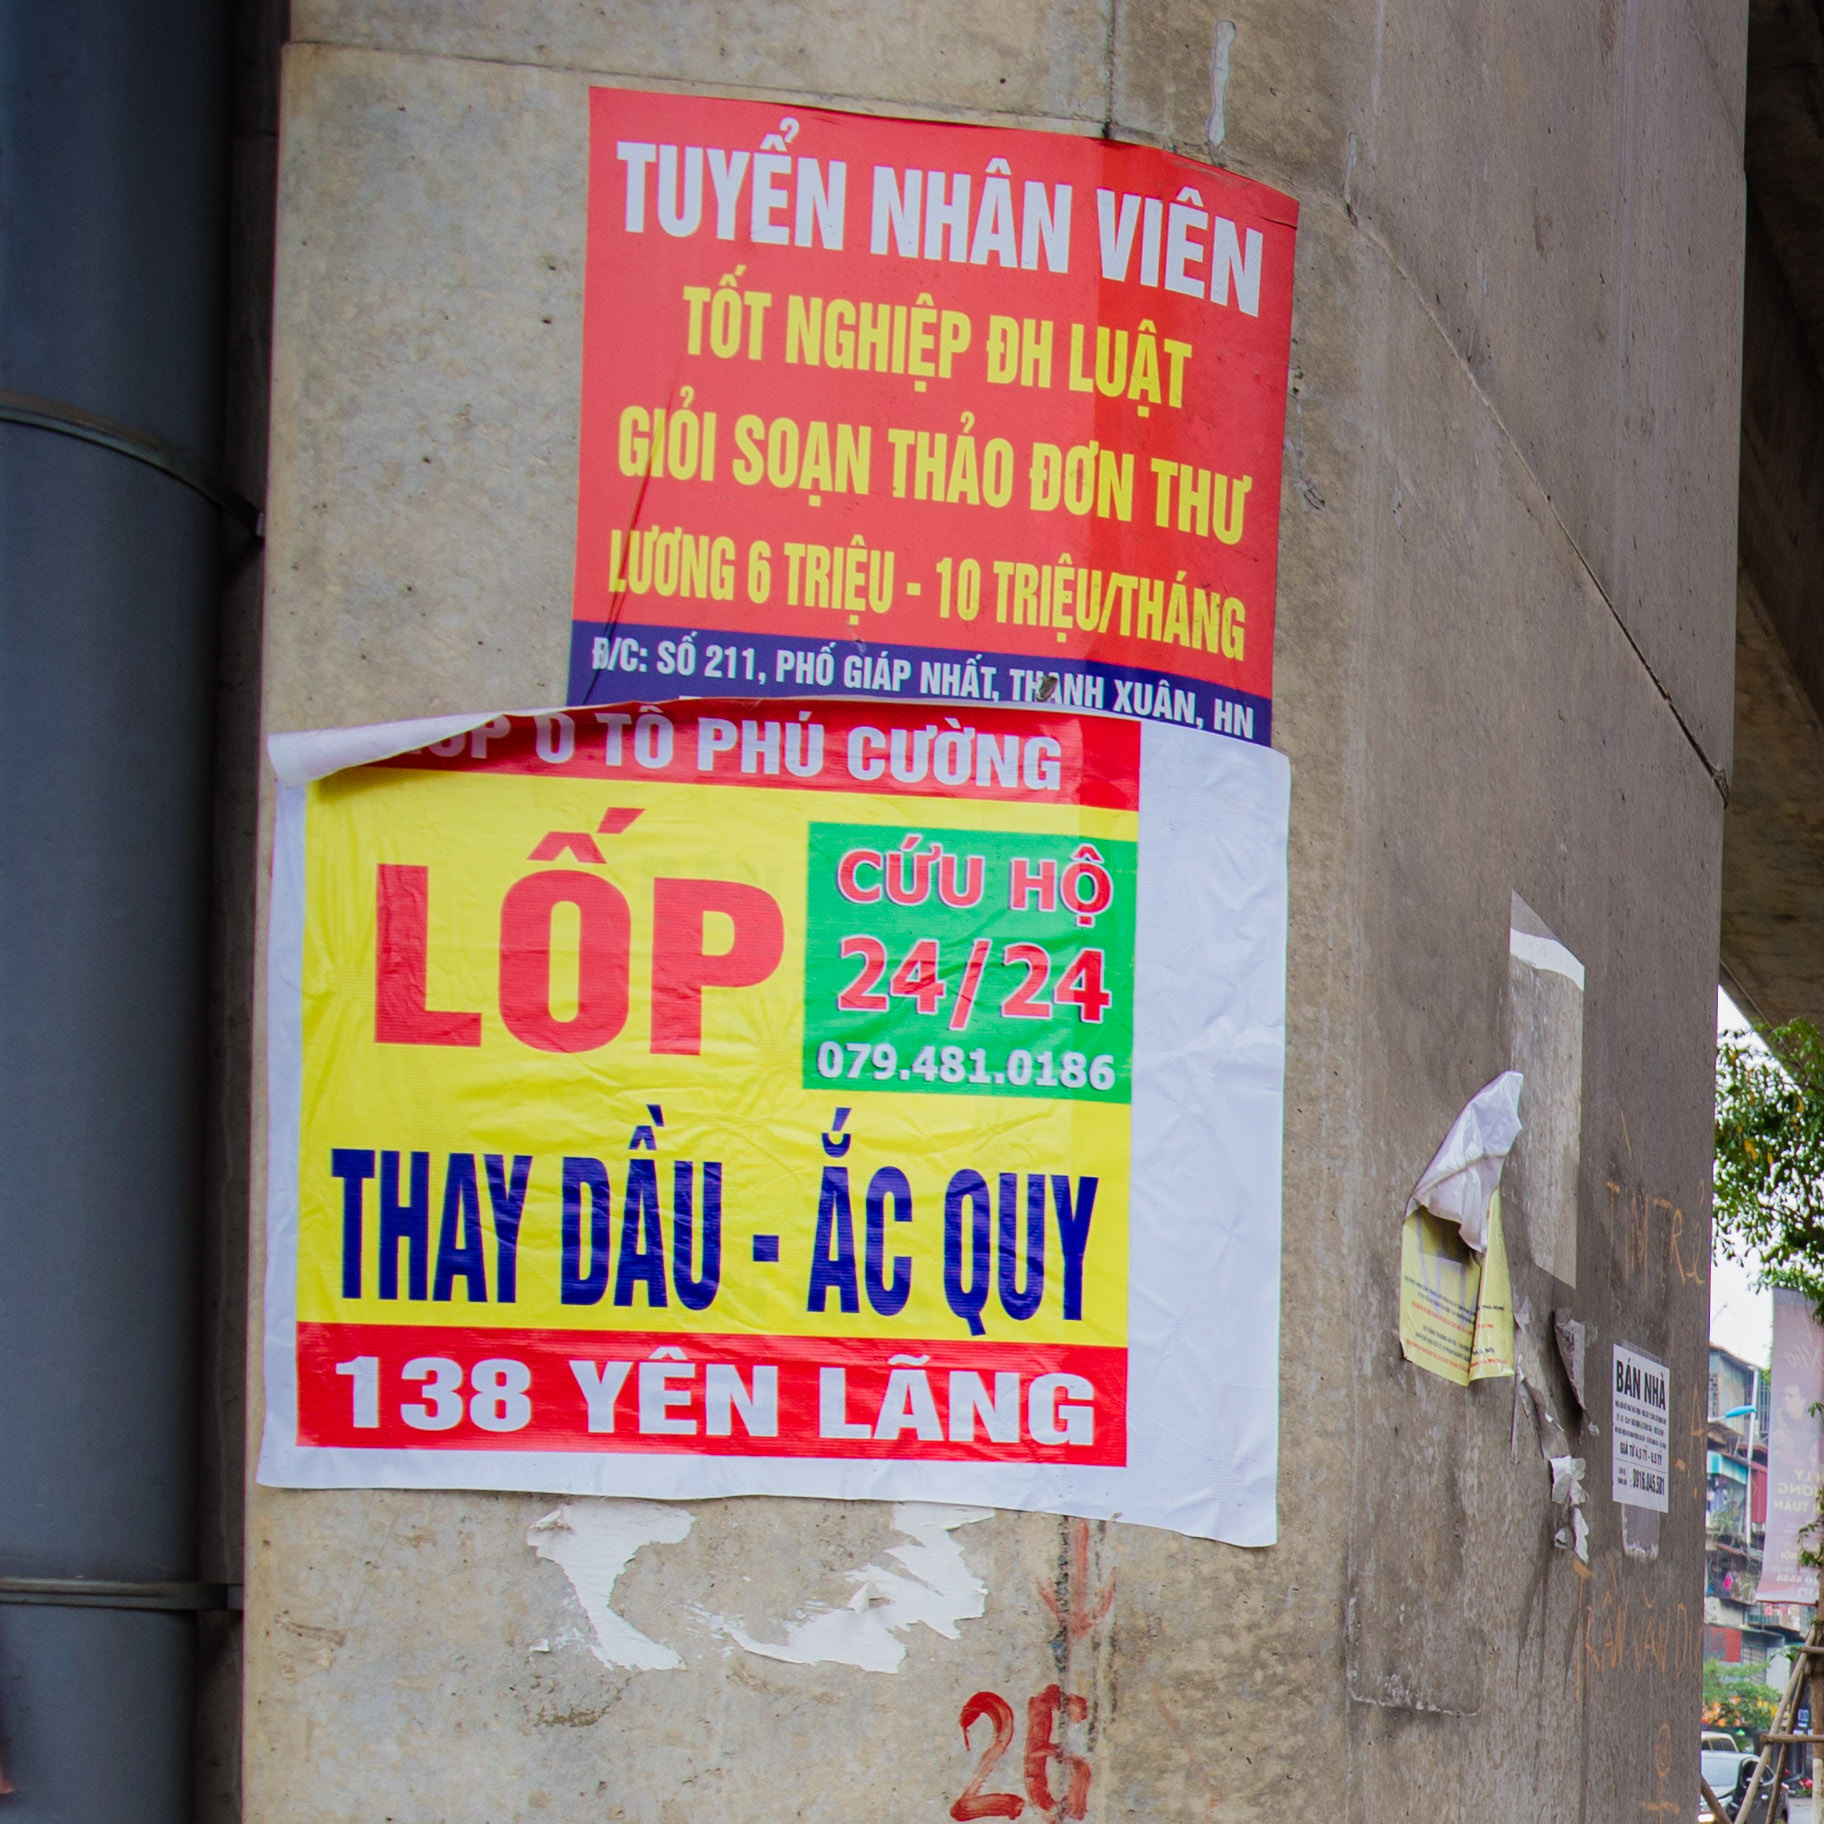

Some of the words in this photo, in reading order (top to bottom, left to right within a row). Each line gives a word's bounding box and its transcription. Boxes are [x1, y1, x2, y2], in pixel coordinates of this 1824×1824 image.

[615, 116, 846, 253] TUYỂN
[871, 156, 1071, 276] NHÂN
[1096, 187, 1265, 319] VIÊN
[682, 263, 772, 363] TỐT
[784, 295, 971, 392] NGHIỆP
[984, 315, 1058, 389] ĐH
[1067, 319, 1193, 419] LUẬT
[616, 384, 717, 481] GIỎI
[732, 410, 871, 508] SOẠN
[888, 410, 1015, 509] THẢO
[1030, 432, 1136, 524] ĐƠN
[1150, 456, 1253, 546] THƯ
[607, 525, 738, 602] LƯƠNG
[745, 542, 771, 602] 6
[782, 532, 897, 627] TRIỆU
[934, 557, 981, 621] 10
[993, 550, 1246, 662] TRIỆU/THÁNG
[590, 635, 648, 674] Đ/C:
[656, 632, 698, 678] SỐ
[703, 645, 767, 689] 211,
[774, 640, 839, 689] PHỐ
[844, 646, 912, 695] GIÁP
[919, 652, 1000, 705] NHẤT,
[1010, 667, 1105, 711] THANH
[1113, 668, 1204, 733] XUÂN,
[1213, 699, 1257, 740] HN
[594, 704, 674, 769] TÔ
[696, 708, 824, 778] PHÚ
[846, 715, 1063, 793] CƯỜNG
[373, 807, 786, 1057] LỐP
[836, 836, 986, 911] CỨU
[1010, 845, 1114, 929] HỘ
[835, 936, 1112, 1031] 24/24
[816, 1041, 1117, 1092] 079.481.0186
[330, 1147, 532, 1304] THAY
[560, 1104, 724, 1312] DẦU
[751, 1233, 781, 1264] -
[805, 1105, 914, 1318] ẮC
[942, 1168, 1099, 1337] QUY
[335, 1355, 532, 1433] 138
[565, 1346, 779, 1439] YÊN
[817, 1353, 1095, 1448] LÃNG
[1615, 1357, 1641, 1401] BÁN
[1644, 1371, 1667, 1412] NHÀ
